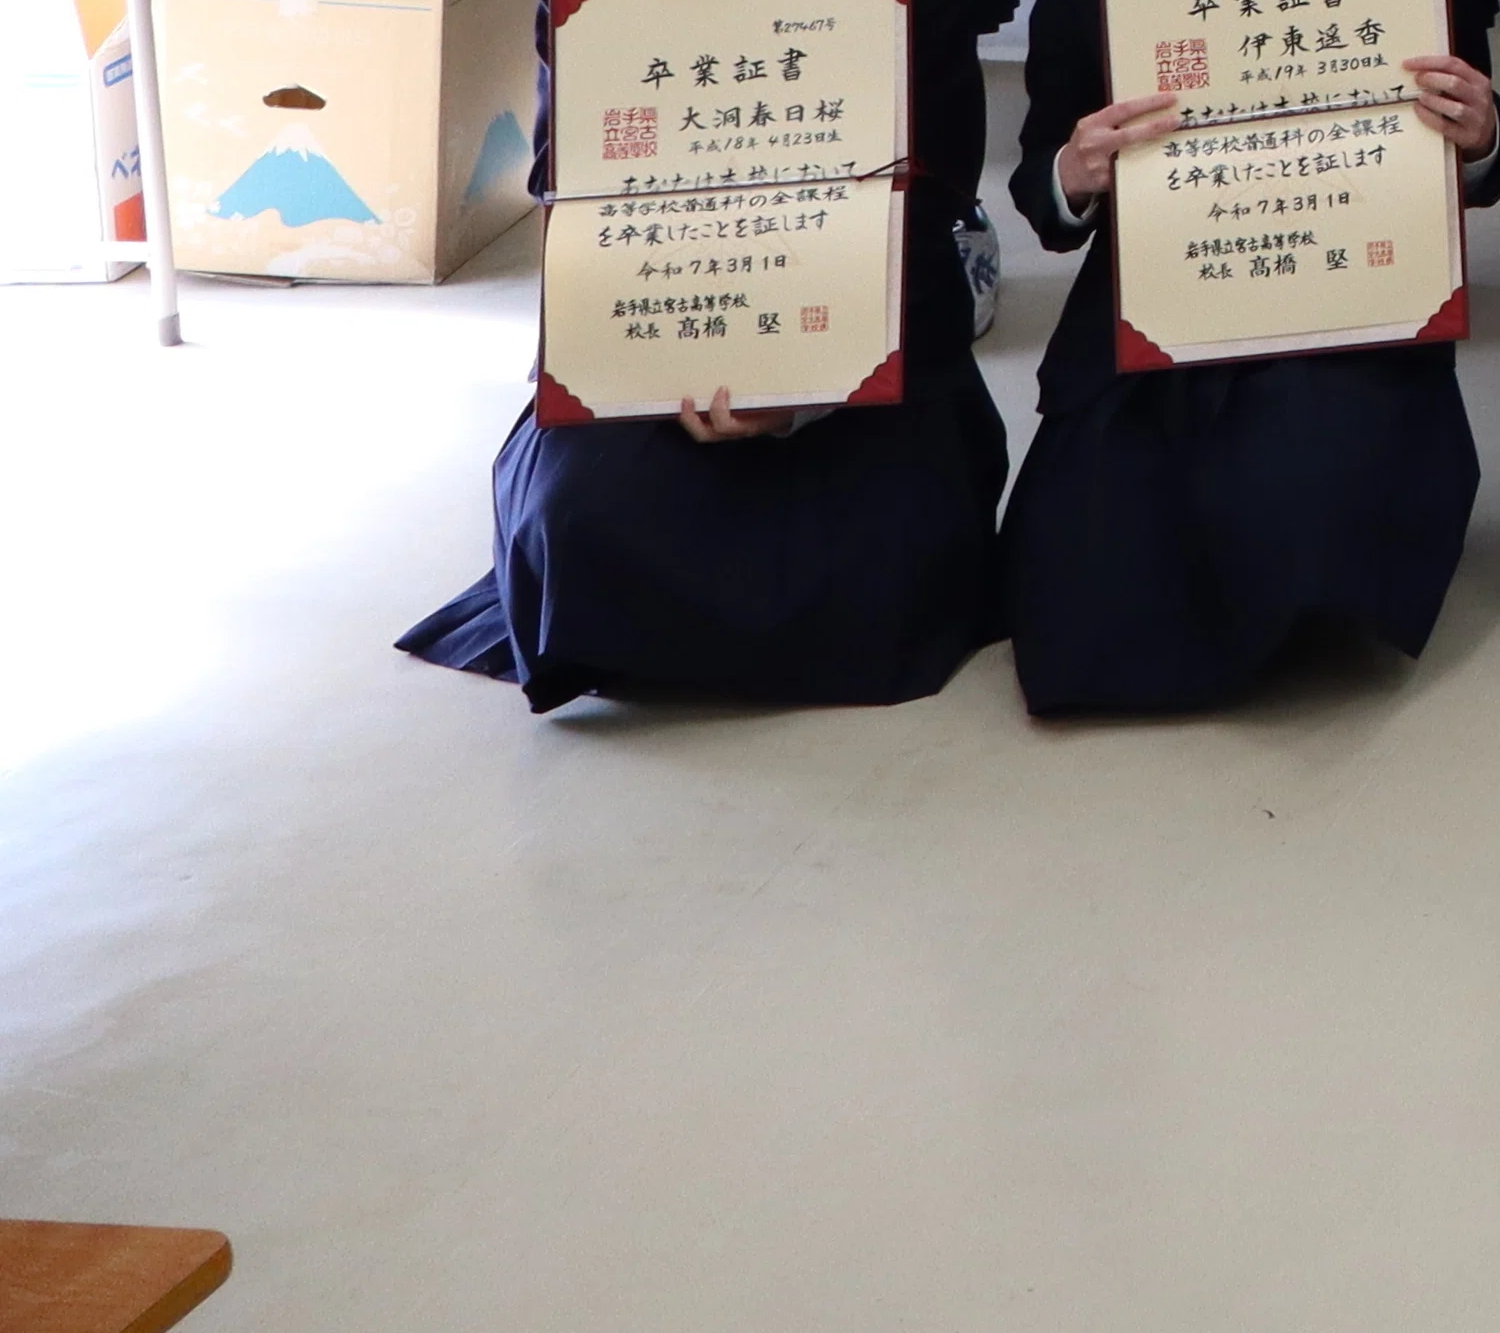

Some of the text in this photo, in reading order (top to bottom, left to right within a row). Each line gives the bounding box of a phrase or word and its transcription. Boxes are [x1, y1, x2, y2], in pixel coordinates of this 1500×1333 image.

[642, 48, 808, 90] 卒業証書
[1167, 146, 1387, 191] を卒業したことを証します
[1208, 193, 1350, 221] 令和7年3月1日
[598, 208, 828, 247] を卒業したことを証します
[636, 254, 787, 281] 令和7年3月1日
